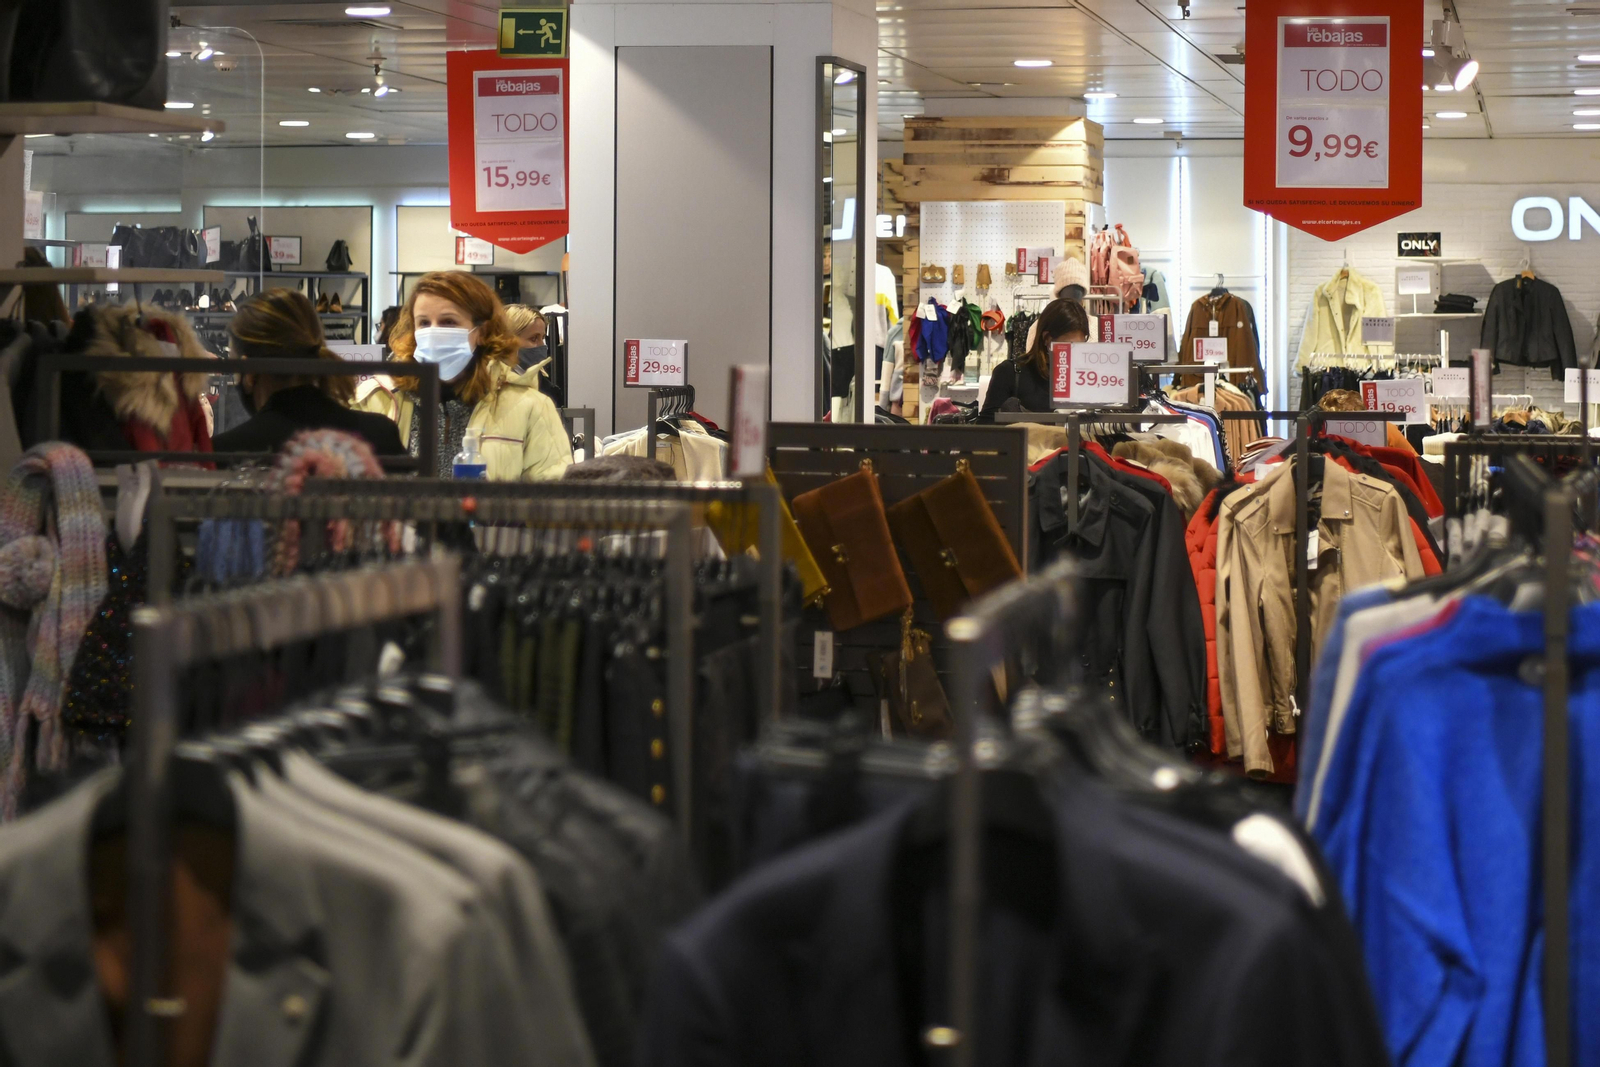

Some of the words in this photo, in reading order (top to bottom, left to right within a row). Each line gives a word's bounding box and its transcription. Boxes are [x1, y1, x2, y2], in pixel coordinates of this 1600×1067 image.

[1307, 29, 1363, 45] rebajas
[496, 80, 541, 94] rebajas
[1300, 69, 1383, 91] TODO
[491, 112, 558, 132] TODO
[1288, 125, 1378, 161] 9,99€
[483, 166, 551, 190] 15,99€
[1401, 239, 1437, 250] ONLY
[1123, 321, 1155, 330] TODO
[648, 347, 678, 356] TODO
[1082, 352, 1120, 365] TODO
[629, 345, 638, 377] rebajas
[642, 361, 682, 374] 29,99€
[1057, 351, 1069, 392] rebajas
[1075, 371, 1125, 388] 39,99€
[1385, 387, 1415, 397] TODO
[1337, 421, 1377, 434] TODO
